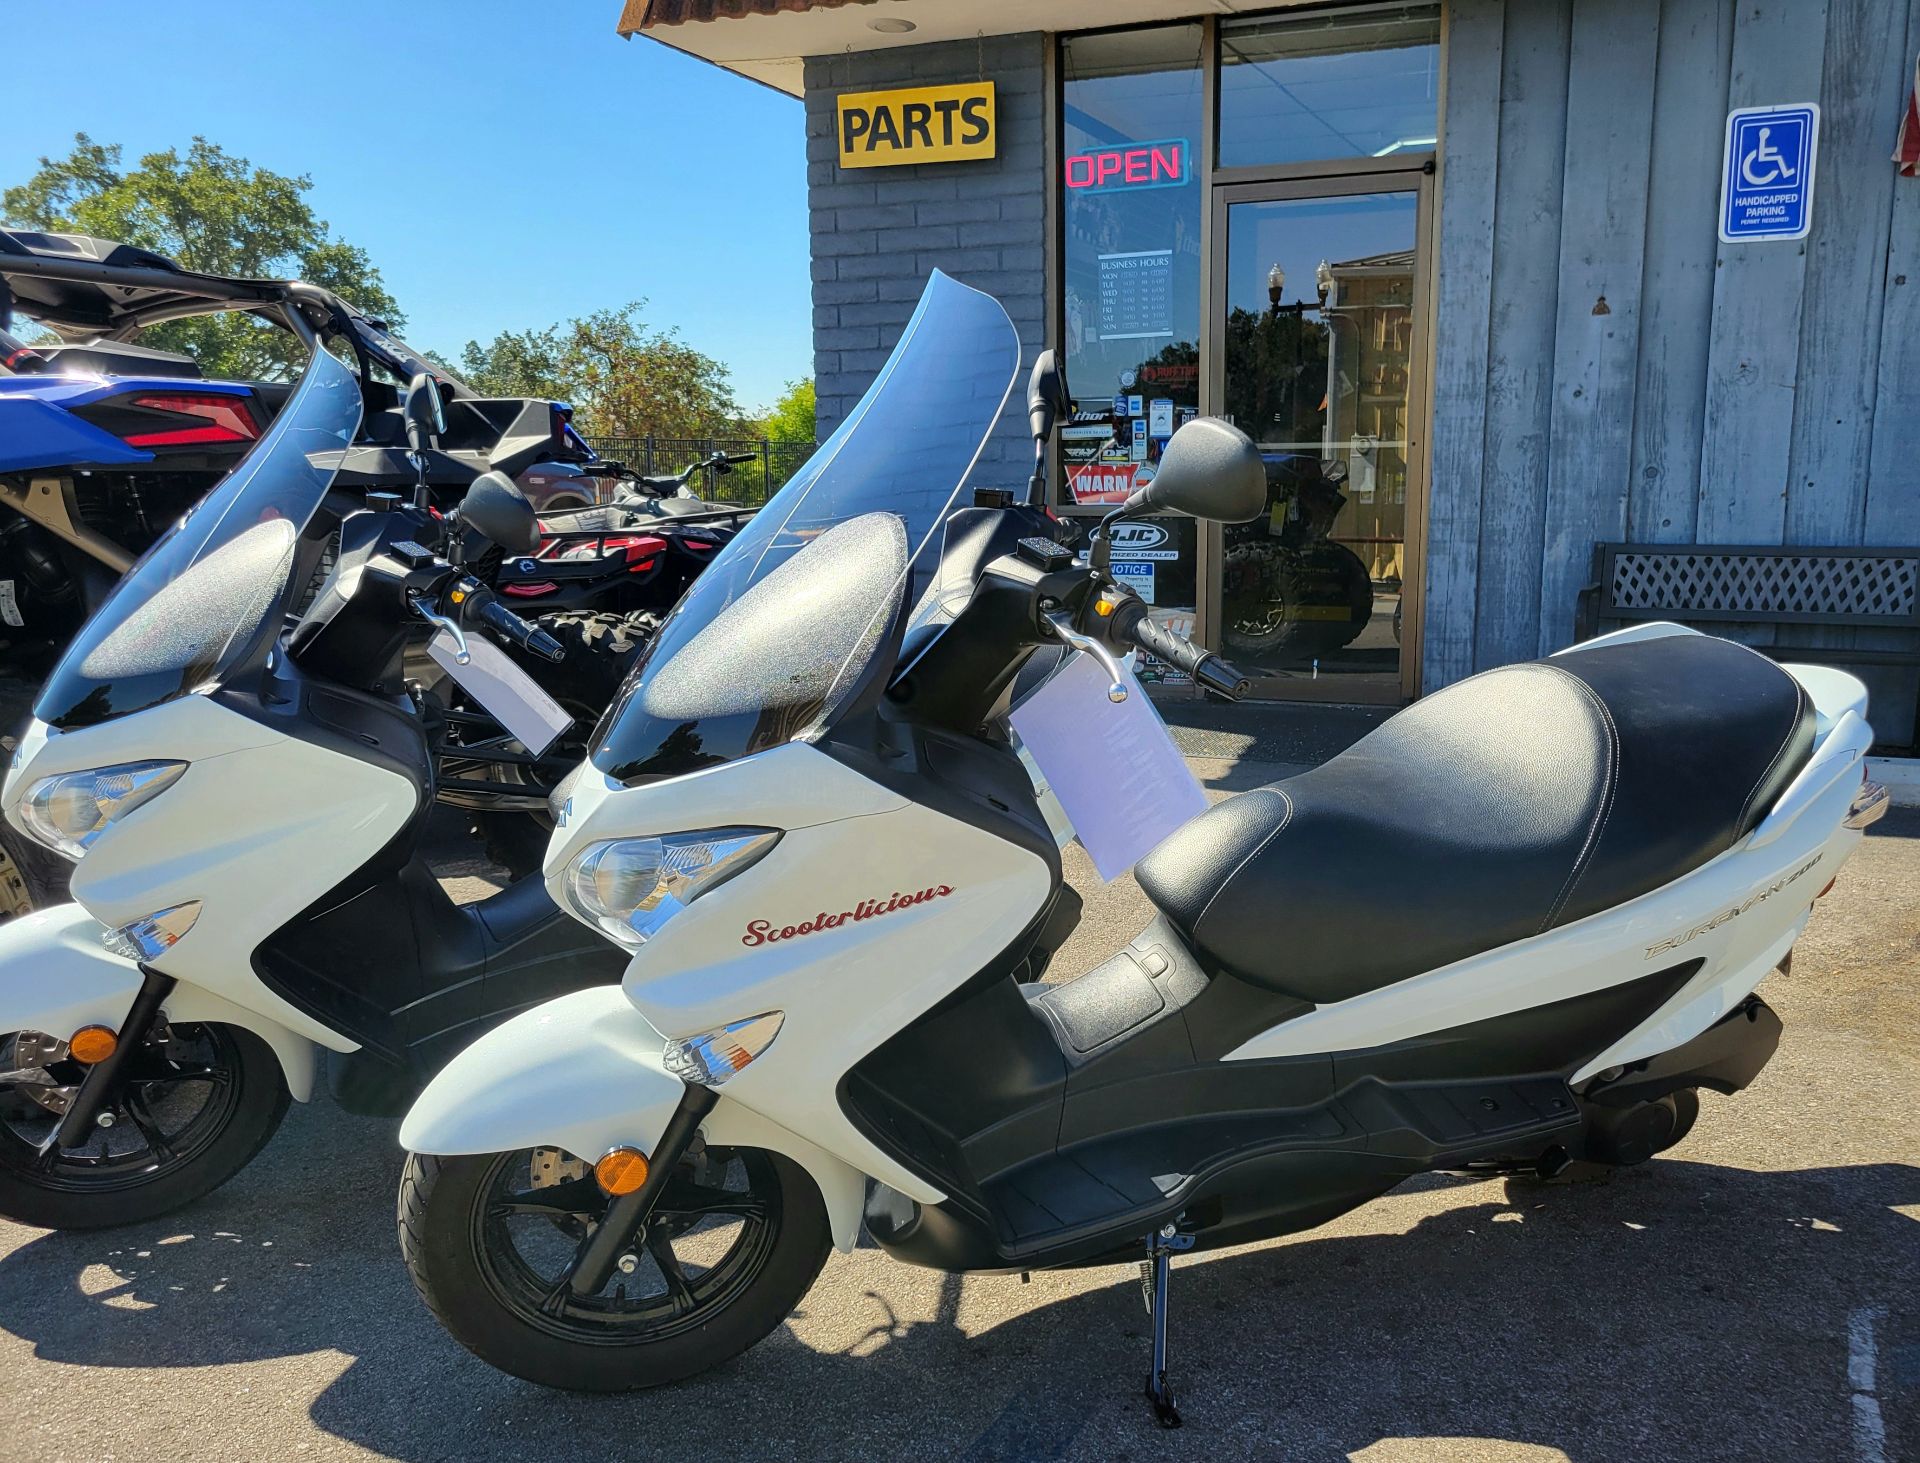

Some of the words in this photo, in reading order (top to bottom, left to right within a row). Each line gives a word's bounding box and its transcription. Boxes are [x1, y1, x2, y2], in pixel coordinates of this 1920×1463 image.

[843, 97, 990, 153] PARTS
[1066, 148, 1178, 188] OPEN
[1735, 194, 1798, 207] HANDICAPPED
[1746, 206, 1785, 217] PARKING
[1101, 260, 1137, 270] BUSINESS
[1140, 258, 1169, 267] HOURS
[1102, 289, 1118, 297] WED
[1074, 412, 1109, 420] thor
[1076, 475, 1128, 492] WARN
[1785, 852, 1823, 886] 200
[741, 884, 957, 947] Scooterlicious
